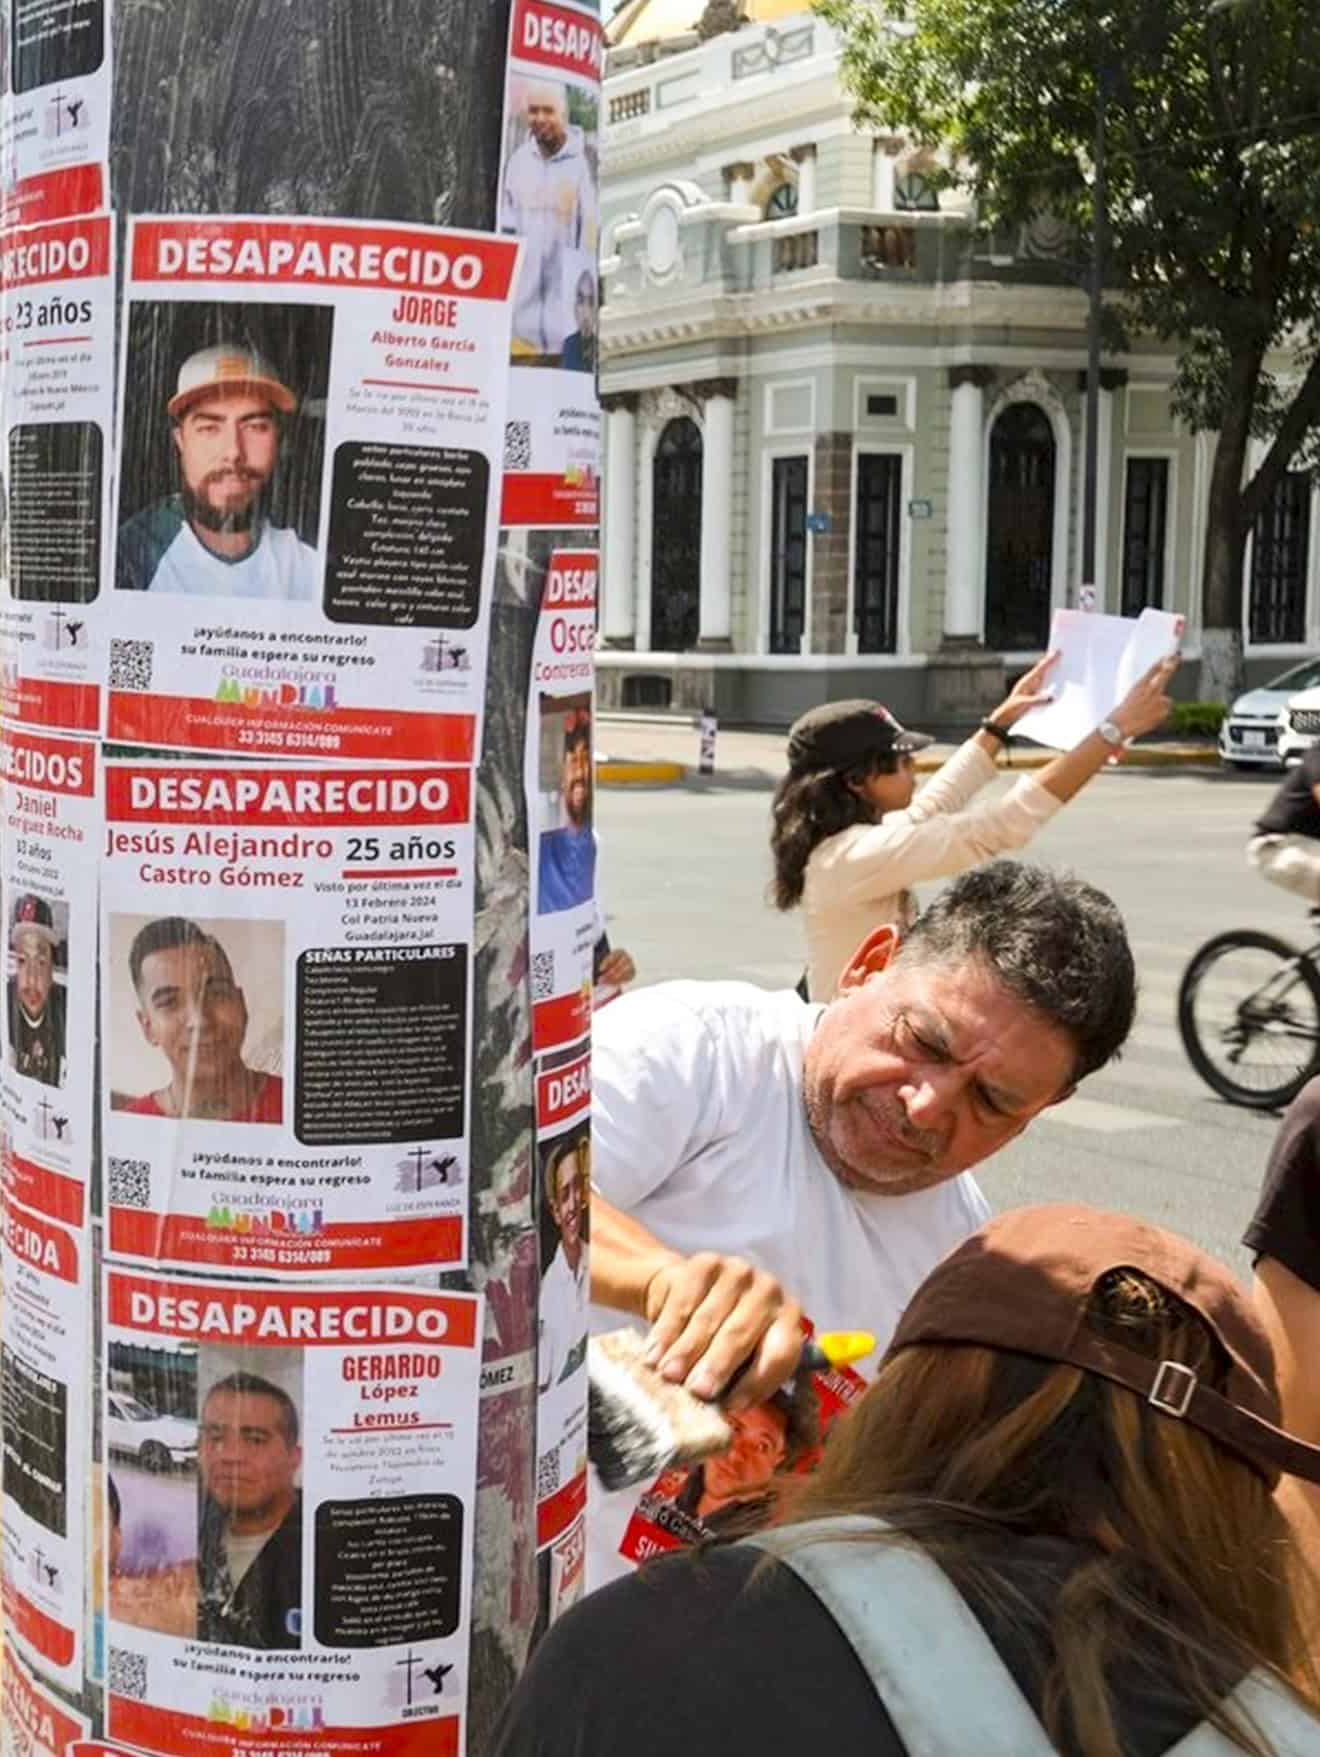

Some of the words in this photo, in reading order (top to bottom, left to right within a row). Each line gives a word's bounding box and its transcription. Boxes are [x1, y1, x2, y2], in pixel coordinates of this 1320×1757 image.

[158, 238, 483, 290] DESAPARECIDO
[38, 296, 92, 326] años
[393, 296, 457, 328] JORGE
[371, 331, 426, 348] Alberto
[431, 337, 475, 352] García
[385, 354, 449, 371] Gonzalez
[281, 631, 367, 646] encontrarlo!
[200, 645, 248, 658] familia
[130, 776, 451, 813] DESAPARECIDO
[106, 829, 175, 857] Jesús
[183, 832, 334, 863] Alejandro
[345, 838, 380, 862] 25
[389, 835, 457, 861] años
[139, 864, 211, 886] Castro
[220, 866, 304, 887] Gómez
[348, 882, 368, 894] por
[356, 946, 455, 962] PARTICULARES
[278, 1156, 363, 1168] encontrarlo!
[200, 1169, 246, 1183] familia
[250, 1174, 295, 1187] espera
[319, 1175, 371, 1188] regreso
[130, 1293, 448, 1339] DESAPARECIDO
[342, 1354, 441, 1381] GERARDO
[361, 1384, 418, 1402] López
[354, 1411, 420, 1426] Lemus
[191, 1660, 237, 1675] familia
[240, 1667, 285, 1682] espera
